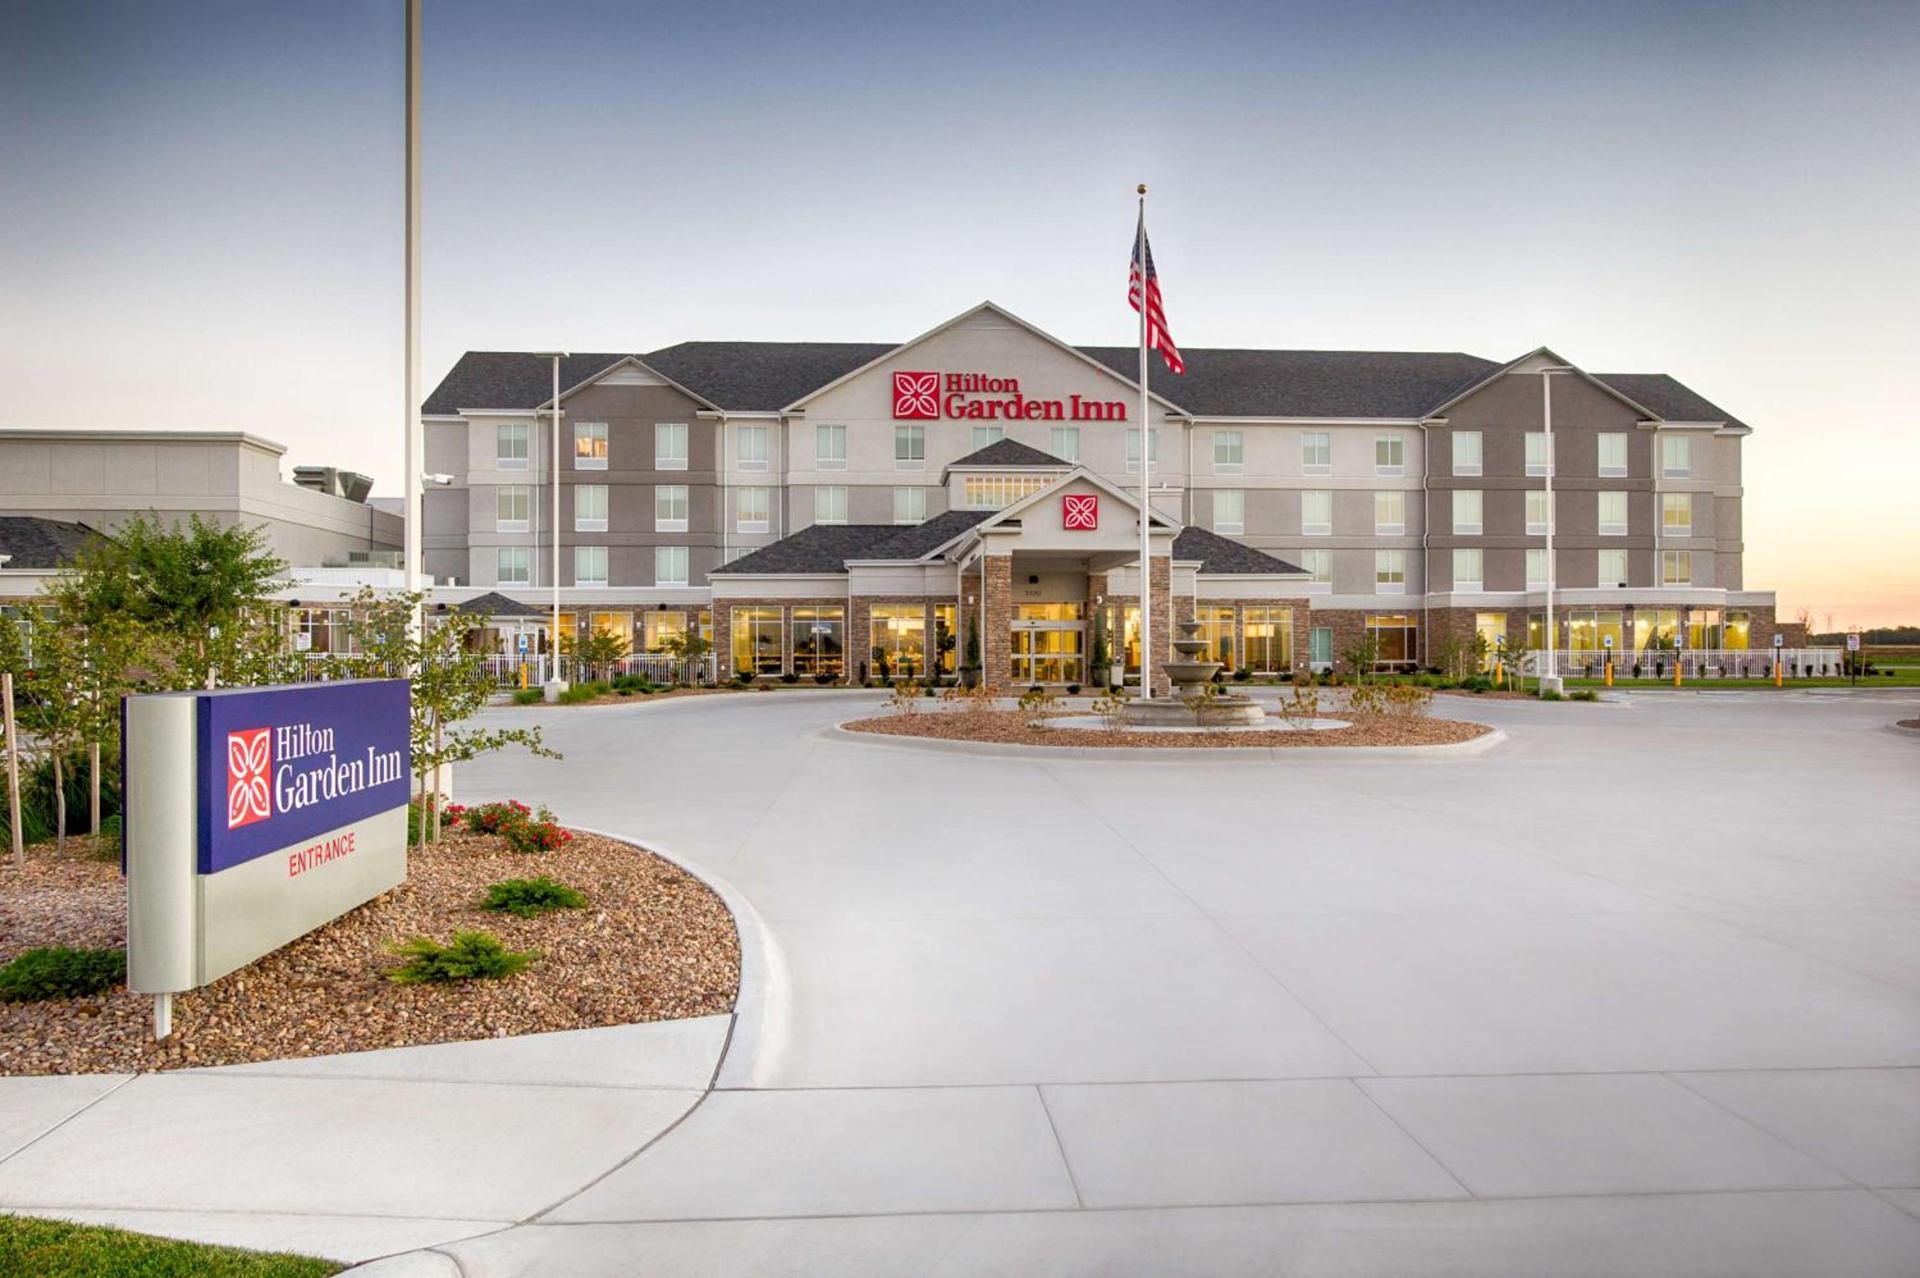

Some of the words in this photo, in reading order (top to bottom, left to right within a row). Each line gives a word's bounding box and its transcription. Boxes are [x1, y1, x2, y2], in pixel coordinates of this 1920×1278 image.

[945, 373, 1019, 393] Hilton
[944, 394, 1065, 420] Garden
[1070, 395, 1127, 421] Inn
[276, 723, 334, 762] Hilton
[275, 754, 365, 813] Garden
[367, 746, 402, 787] Inn
[289, 833, 355, 877] ENTRANCE
